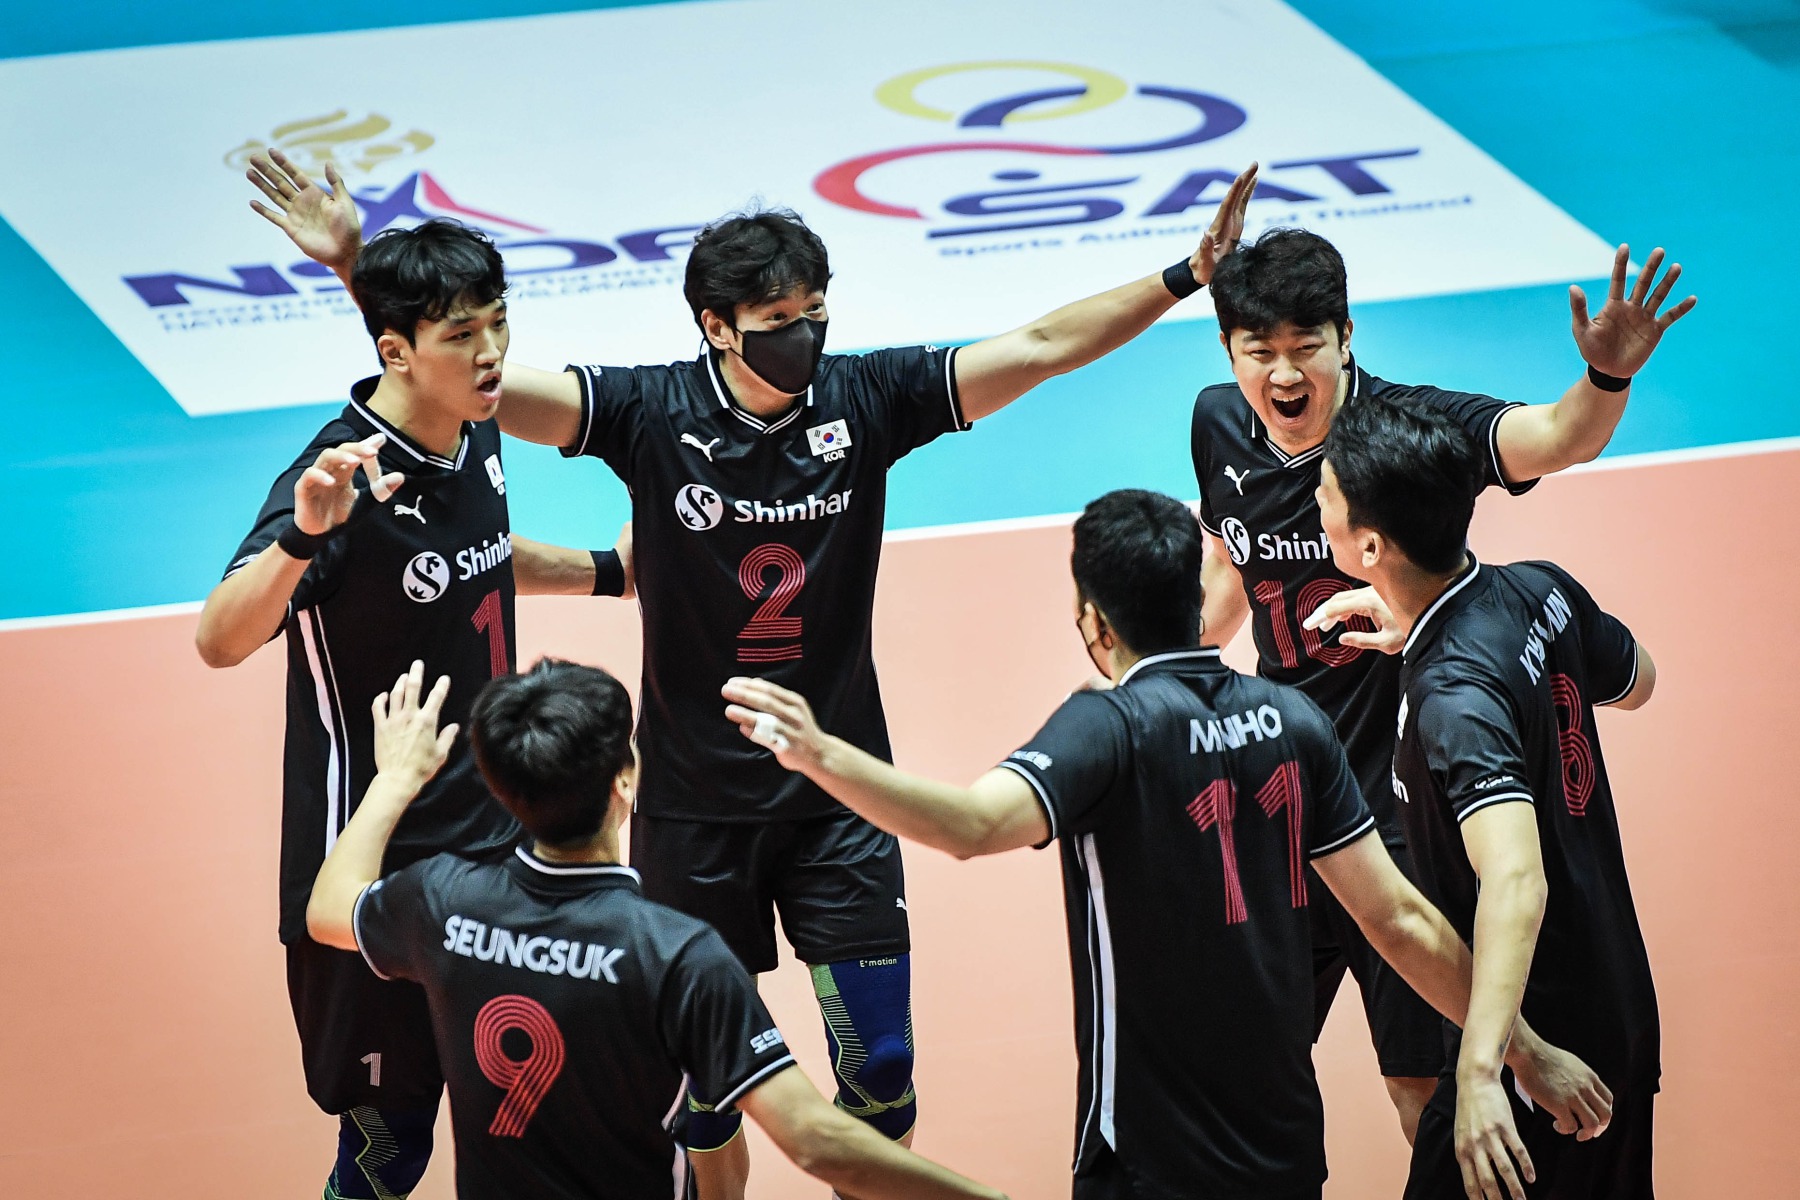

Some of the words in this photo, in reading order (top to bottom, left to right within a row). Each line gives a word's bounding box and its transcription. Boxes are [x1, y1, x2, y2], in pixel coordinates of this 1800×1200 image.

[927, 147, 1422, 238] SAT
[1077, 222, 1208, 245] Author
[823, 449, 846, 463] KOR
[456, 531, 513, 581] Shinha
[1257, 532, 1332, 561] Shinh
[737, 543, 805, 662] 2
[470, 588, 509, 681] 1
[1189, 704, 1283, 755] MNHO
[1186, 760, 1308, 926] 11
[443, 914, 626, 985] SEUNGSUK
[360, 1052, 381, 1087] 1
[473, 993, 566, 1139] 9
